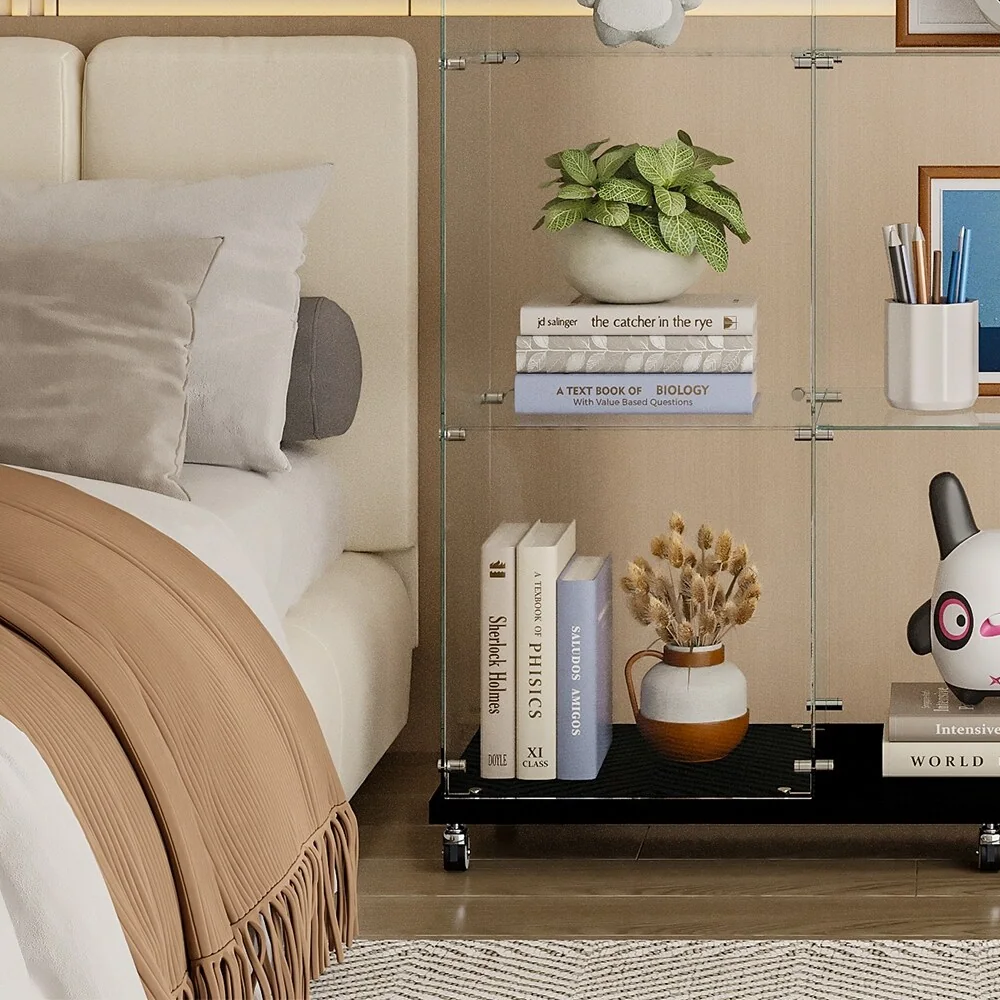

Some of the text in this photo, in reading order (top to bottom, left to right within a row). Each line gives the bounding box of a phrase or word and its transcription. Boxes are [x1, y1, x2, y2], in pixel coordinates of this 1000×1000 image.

[537, 315, 713, 331] jd salinger the catcher in the rye
[556, 385, 710, 396] A TEXT BOOK OF BIOLOGY
[573, 398, 693, 407] With Value Based Questions
[534, 625, 542, 637] OF
[489, 616, 507, 715] Sherlock Holmes
[529, 642, 542, 719] PHISICS
[571, 626, 581, 736] SALUDOS AMIGOS
[527, 747, 543, 758] XI
[488, 754, 508, 767] DOYLE
[522, 760, 549, 768] CLASS
[910, 755, 984, 767] WORLD
